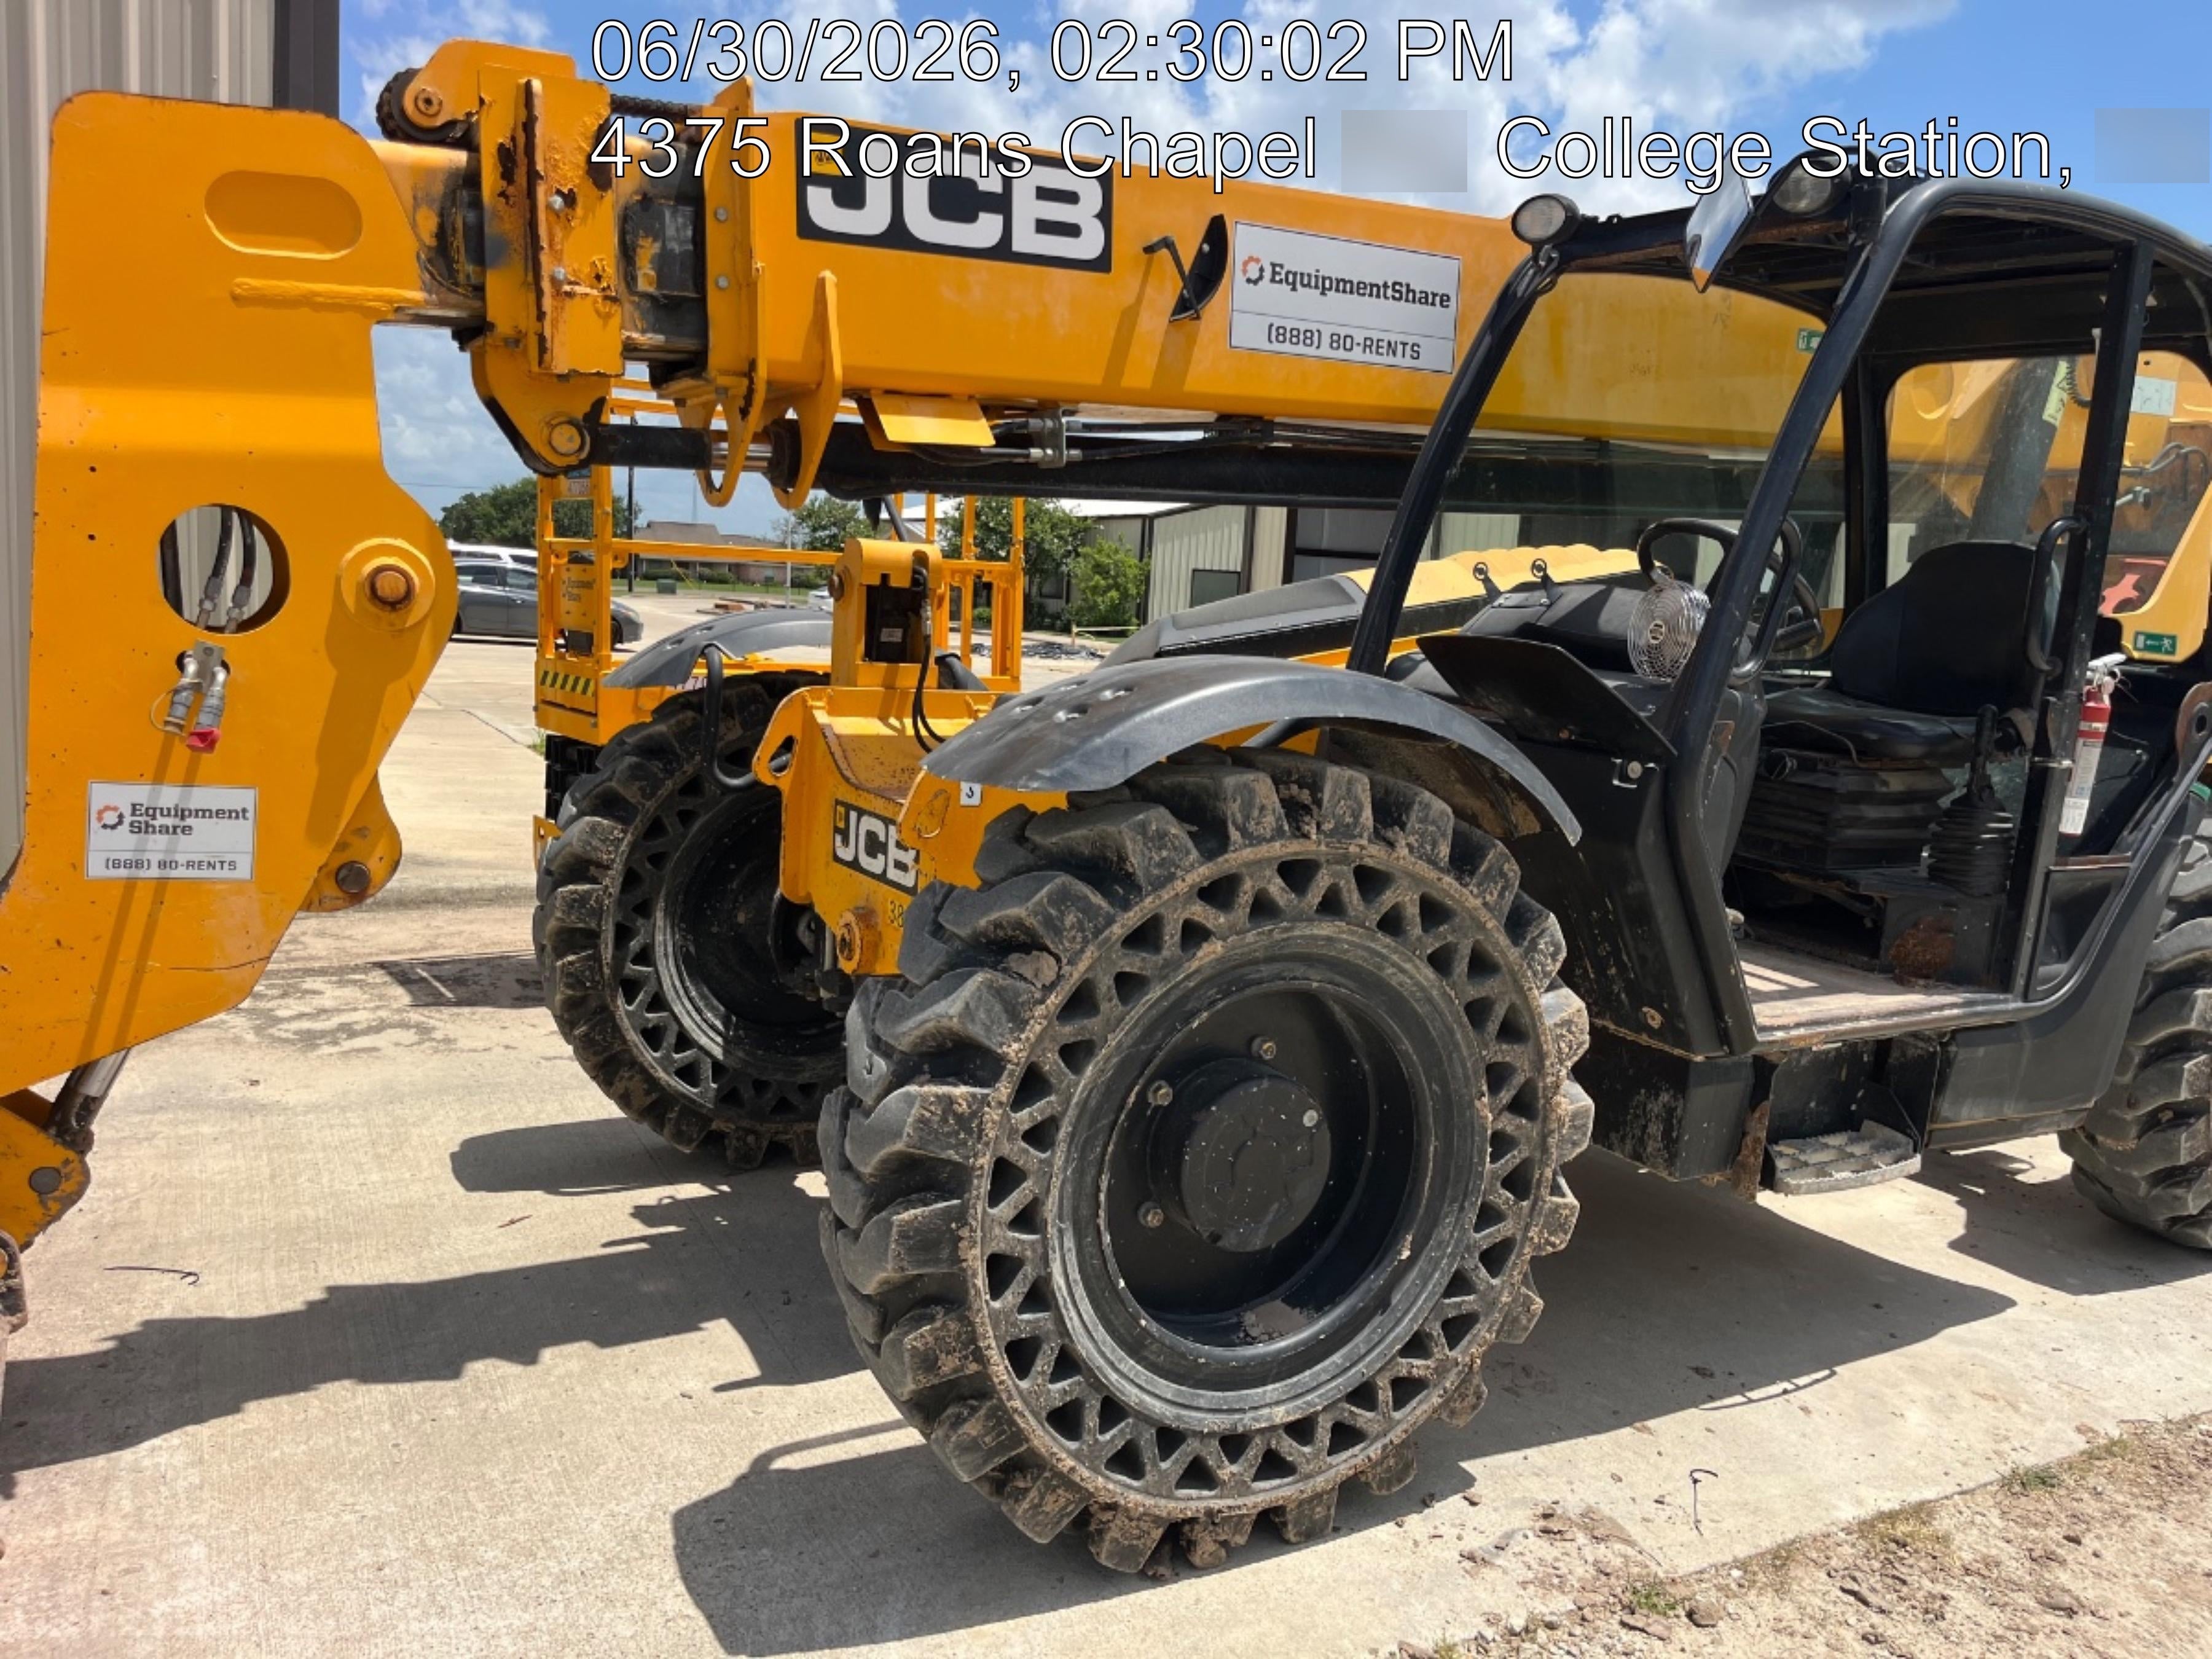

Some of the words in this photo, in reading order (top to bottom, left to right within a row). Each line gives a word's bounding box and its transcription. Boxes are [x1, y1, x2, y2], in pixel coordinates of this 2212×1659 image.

[806, 136, 1105, 261] JCB
[1269, 261, 1451, 308] EquipmentShare
[1267, 322, 1322, 349] (888)
[1328, 333, 1421, 361] 80-RENTS
[129, 802, 249, 821] Equipment
[128, 820, 194, 836] Share
[105, 857, 151, 870] (888)
